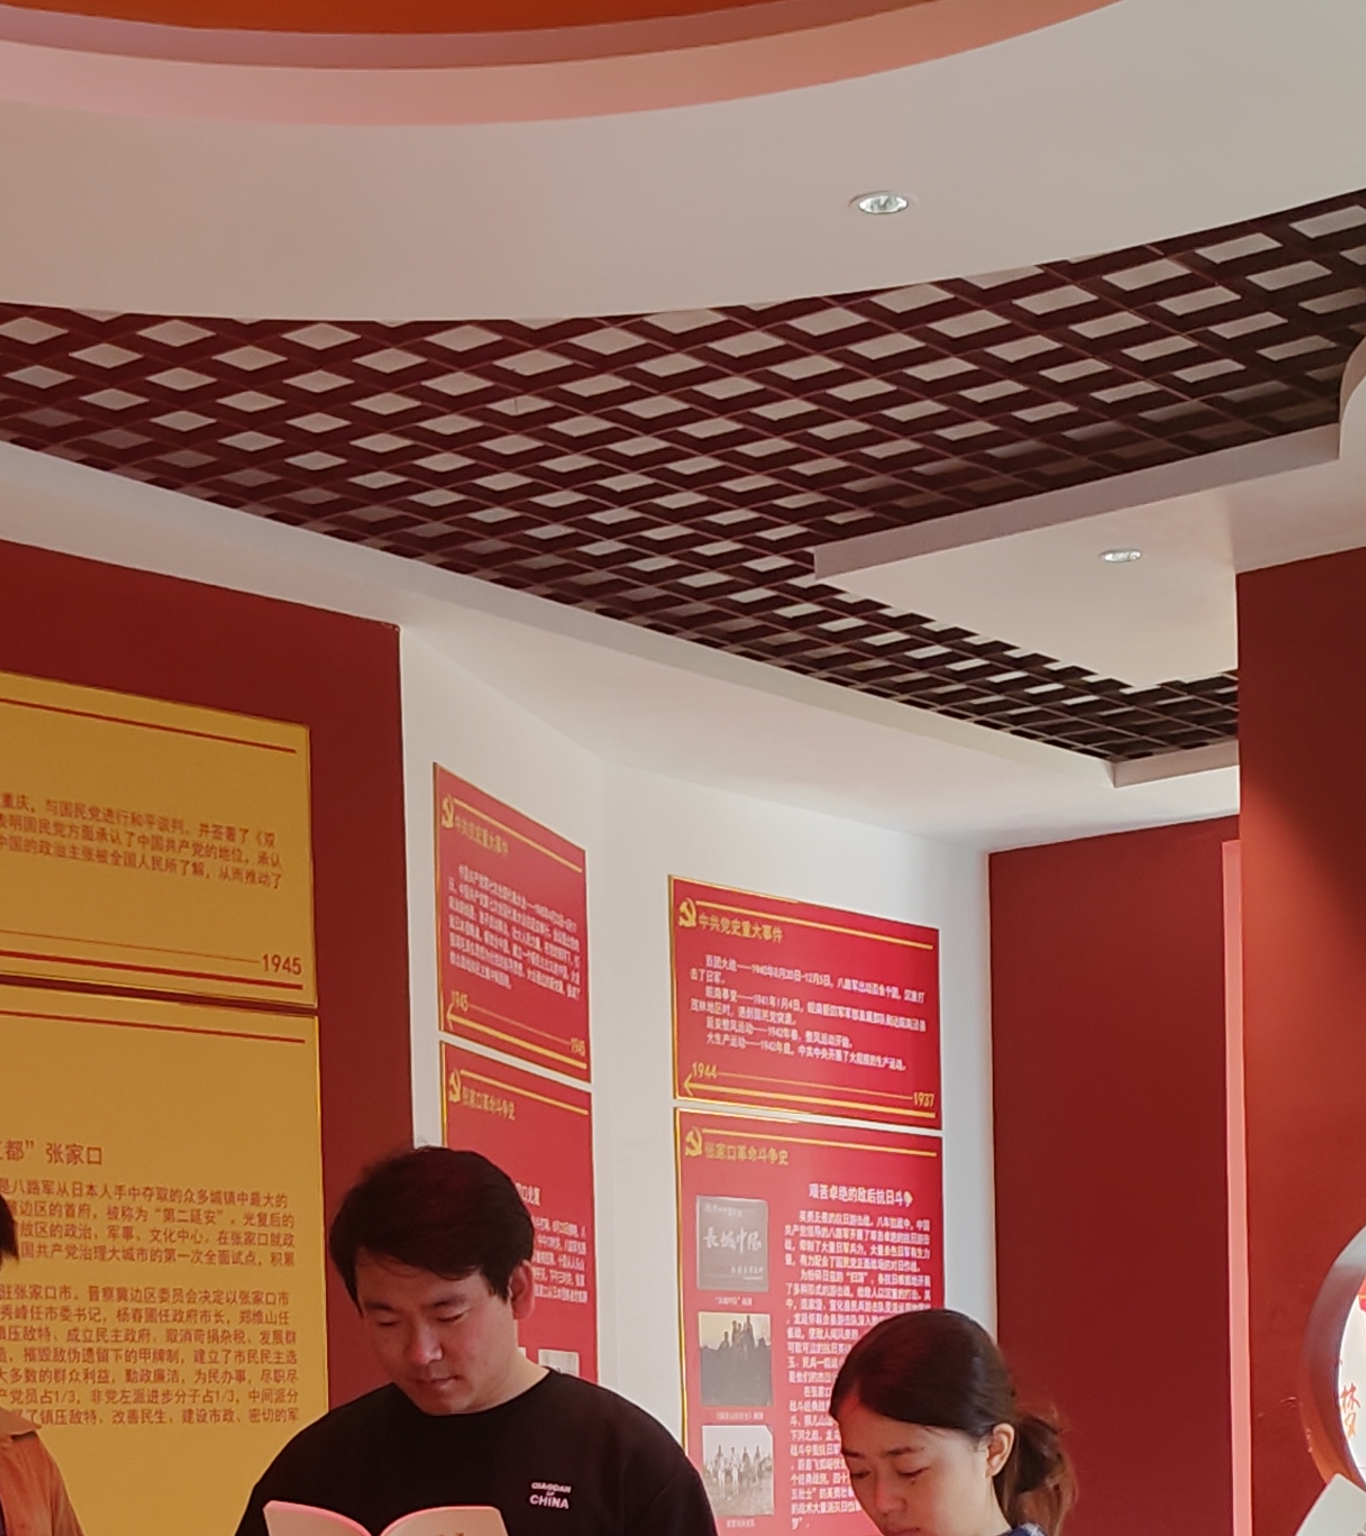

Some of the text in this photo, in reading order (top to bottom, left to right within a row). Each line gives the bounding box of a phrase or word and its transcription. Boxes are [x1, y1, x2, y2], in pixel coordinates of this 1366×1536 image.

[262, 953, 303, 976] 1945
[691, 1061, 719, 1081] 1944
[529, 1494, 570, 1510] CHINA
